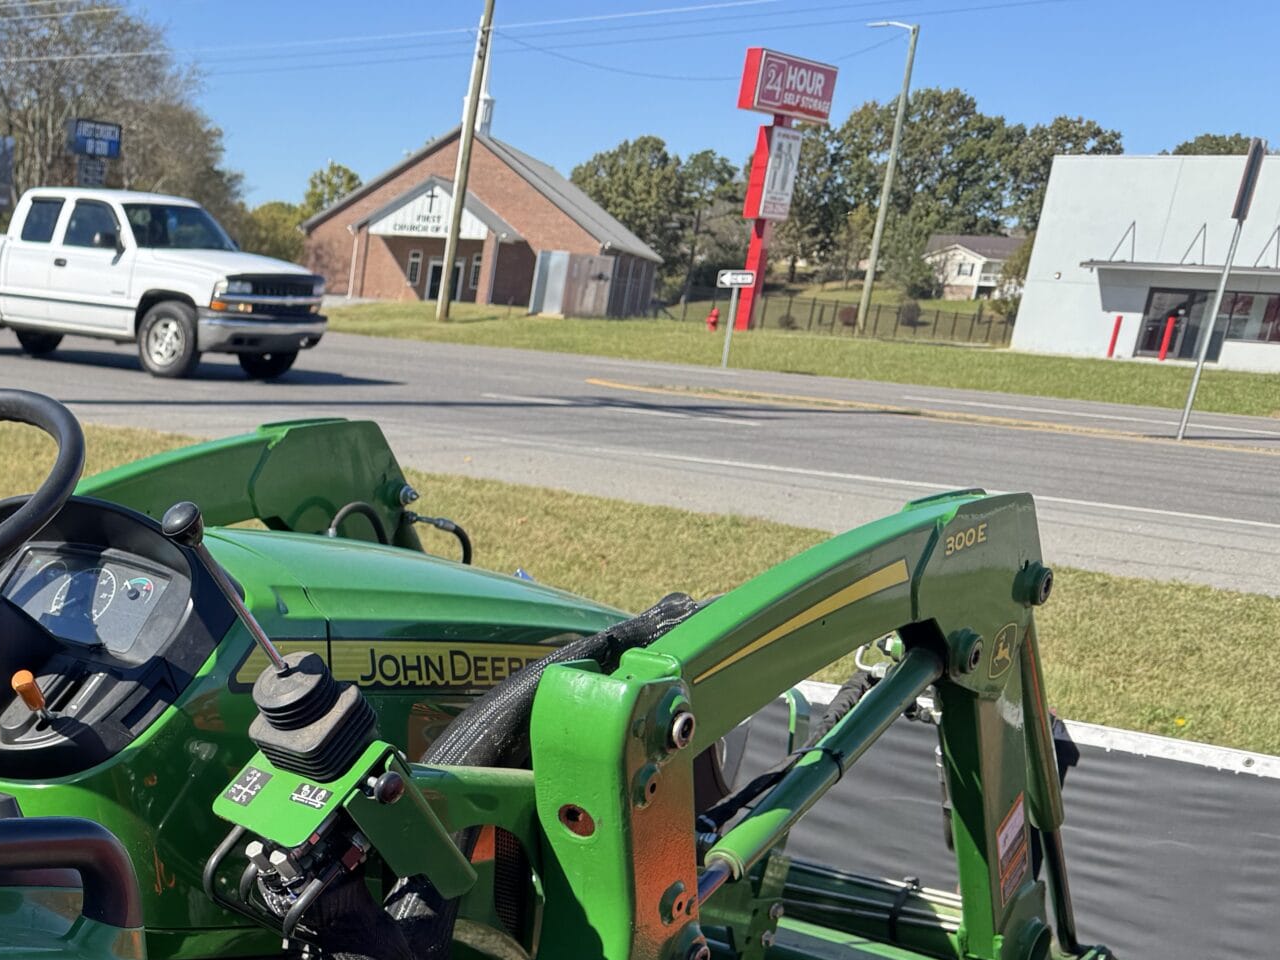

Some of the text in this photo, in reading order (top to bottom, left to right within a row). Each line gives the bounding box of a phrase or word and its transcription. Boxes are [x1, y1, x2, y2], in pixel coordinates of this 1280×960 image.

[766, 63, 826, 100] 24 HOUR
[783, 92, 831, 113] SELF STORAGE
[360, 648, 541, 683] JOHN DEER
